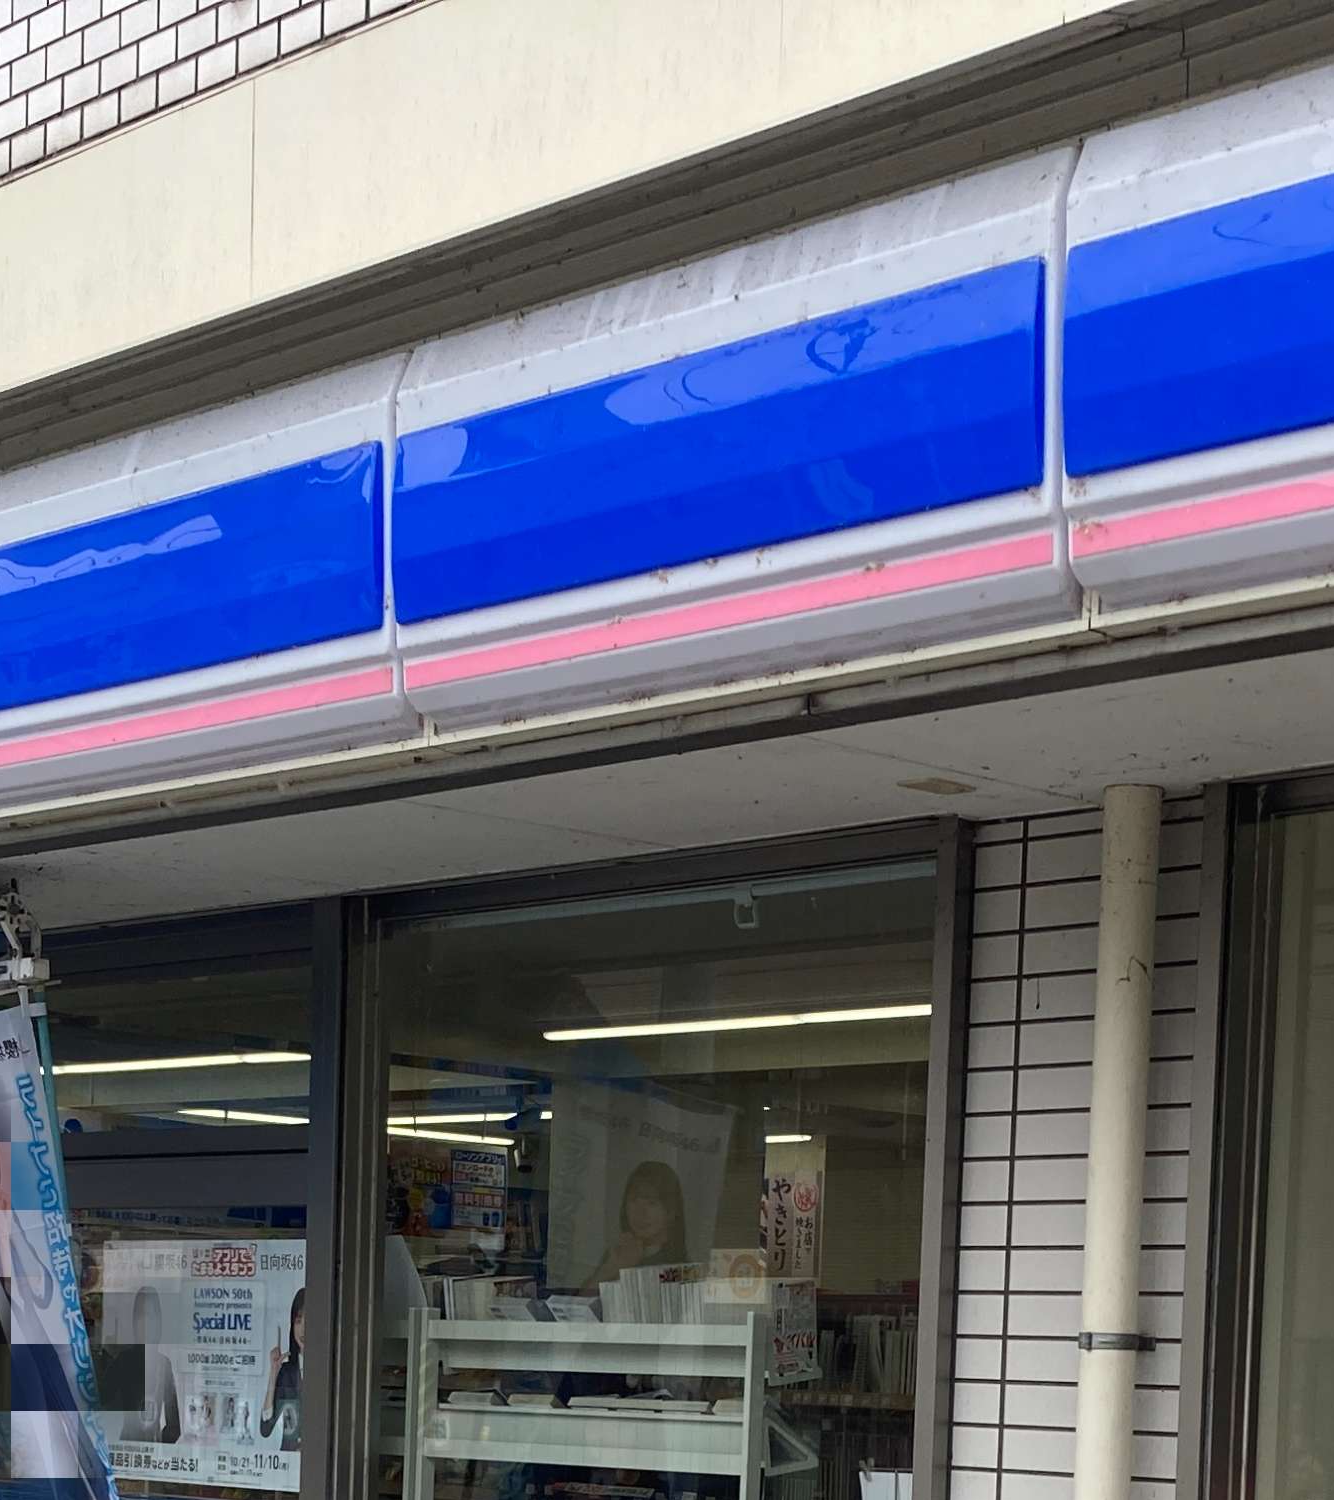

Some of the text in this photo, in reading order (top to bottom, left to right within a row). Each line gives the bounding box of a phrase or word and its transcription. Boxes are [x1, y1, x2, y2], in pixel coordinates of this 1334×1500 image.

[193, 1287, 253, 1300] LAWSON 50th
[192, 1312, 252, 1333] Special LIVE
